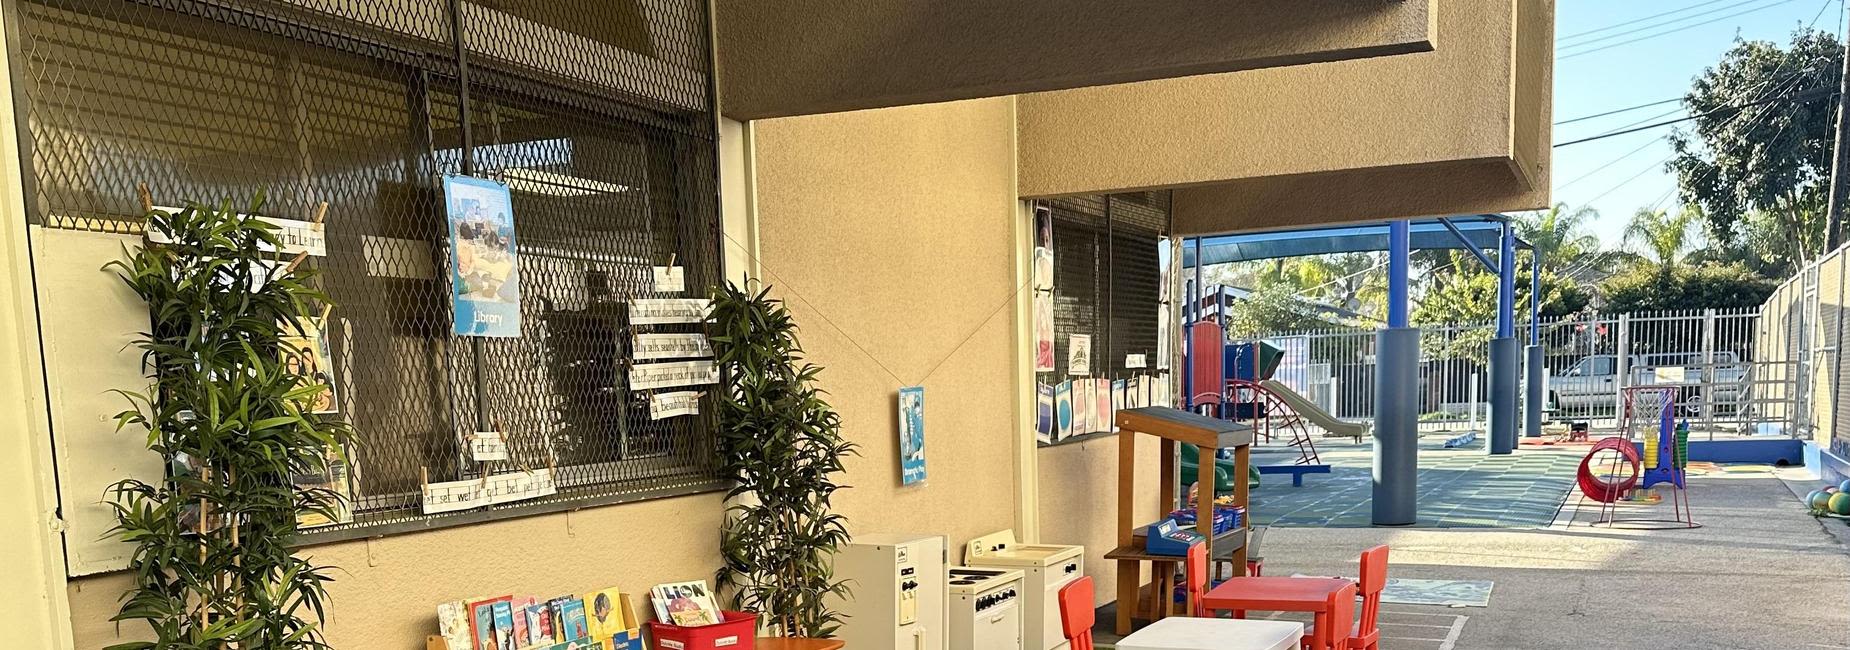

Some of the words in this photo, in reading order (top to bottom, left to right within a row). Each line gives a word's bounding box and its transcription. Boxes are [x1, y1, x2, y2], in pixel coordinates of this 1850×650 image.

[287, 226, 296, 245] to
[474, 310, 503, 326] Library
[457, 486, 471, 502] wet
